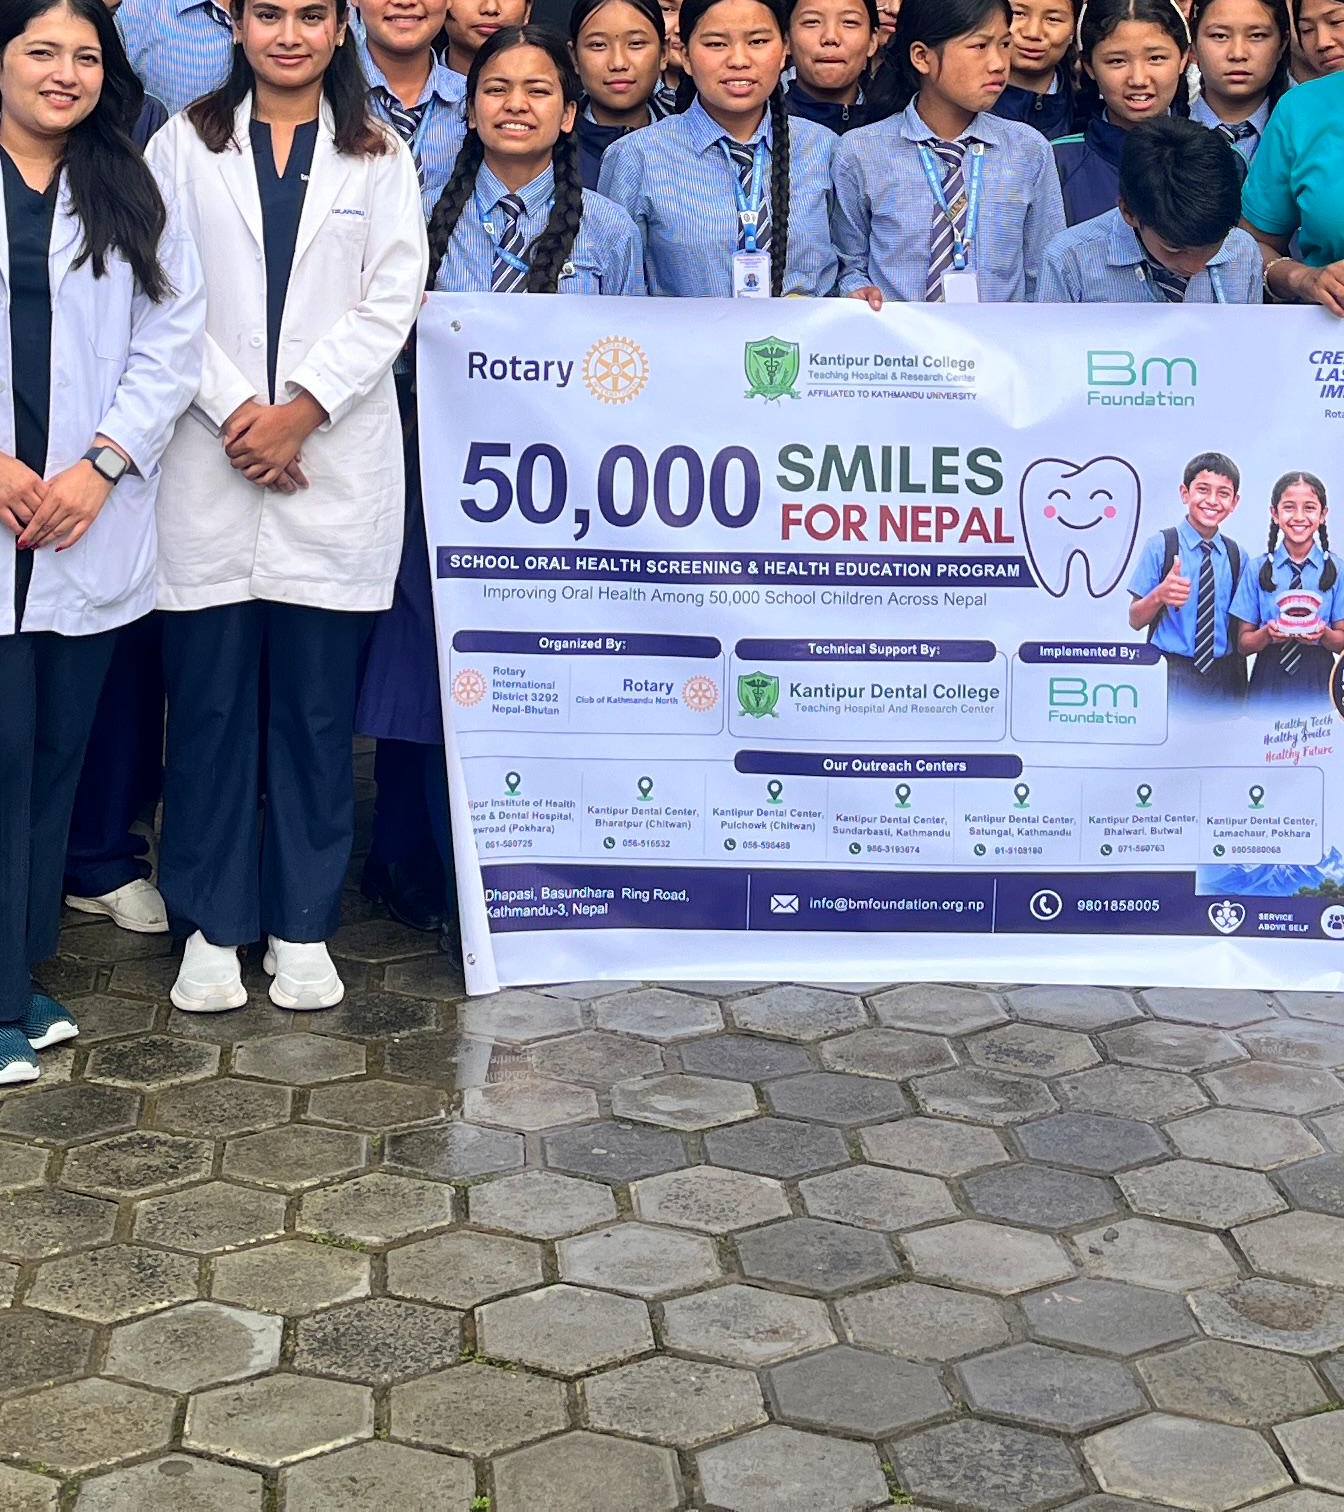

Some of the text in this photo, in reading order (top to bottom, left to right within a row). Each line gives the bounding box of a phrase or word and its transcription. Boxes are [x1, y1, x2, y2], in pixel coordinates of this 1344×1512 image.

[467, 351, 574, 388] Rotary
[809, 353, 975, 371] Kantipur Dental College
[1087, 350, 1197, 387] Bm
[808, 370, 943, 382] Teaching Hospital Research
[807, 390, 977, 401] AFFILIATED KATHMANDU UNIVERSITY
[1087, 391, 1195, 407] Foundation
[459, 441, 1003, 541] 50,000 SMILES
[780, 502, 1015, 545] FOR NEPAL
[450, 554, 1020, 578] SCHOOL ORAL HEALTH SCREENING & HEALTH EDUCATION PROGRAM
[483, 584, 987, 609] Improving Oral Health Among 50,000 School Children Across Nepal
[538, 637, 627, 651] Organized By:
[807, 643, 941, 657] Technical Support By:
[1039, 645, 1140, 661] Implemented By:
[493, 666, 526, 677] Rotary
[492, 679, 555, 689] International
[622, 678, 674, 695] Rotary
[492, 691, 529, 702] District
[789, 683, 1001, 702] Kantipur Dental College
[1048, 677, 1138, 708] Bm
[491, 704, 560, 716] Nepal-Bhutan
[795, 703, 995, 715] Teaching Hospital Center
[1048, 710, 1137, 725] Foundation
[823, 759, 967, 772] Our Outreach Centers
[542, 887, 690, 903] Basundhara Ring Road,
[572, 903, 608, 918] Nepal
[809, 896, 1160, 913] info@bmfoundation.org.np 9801858005
